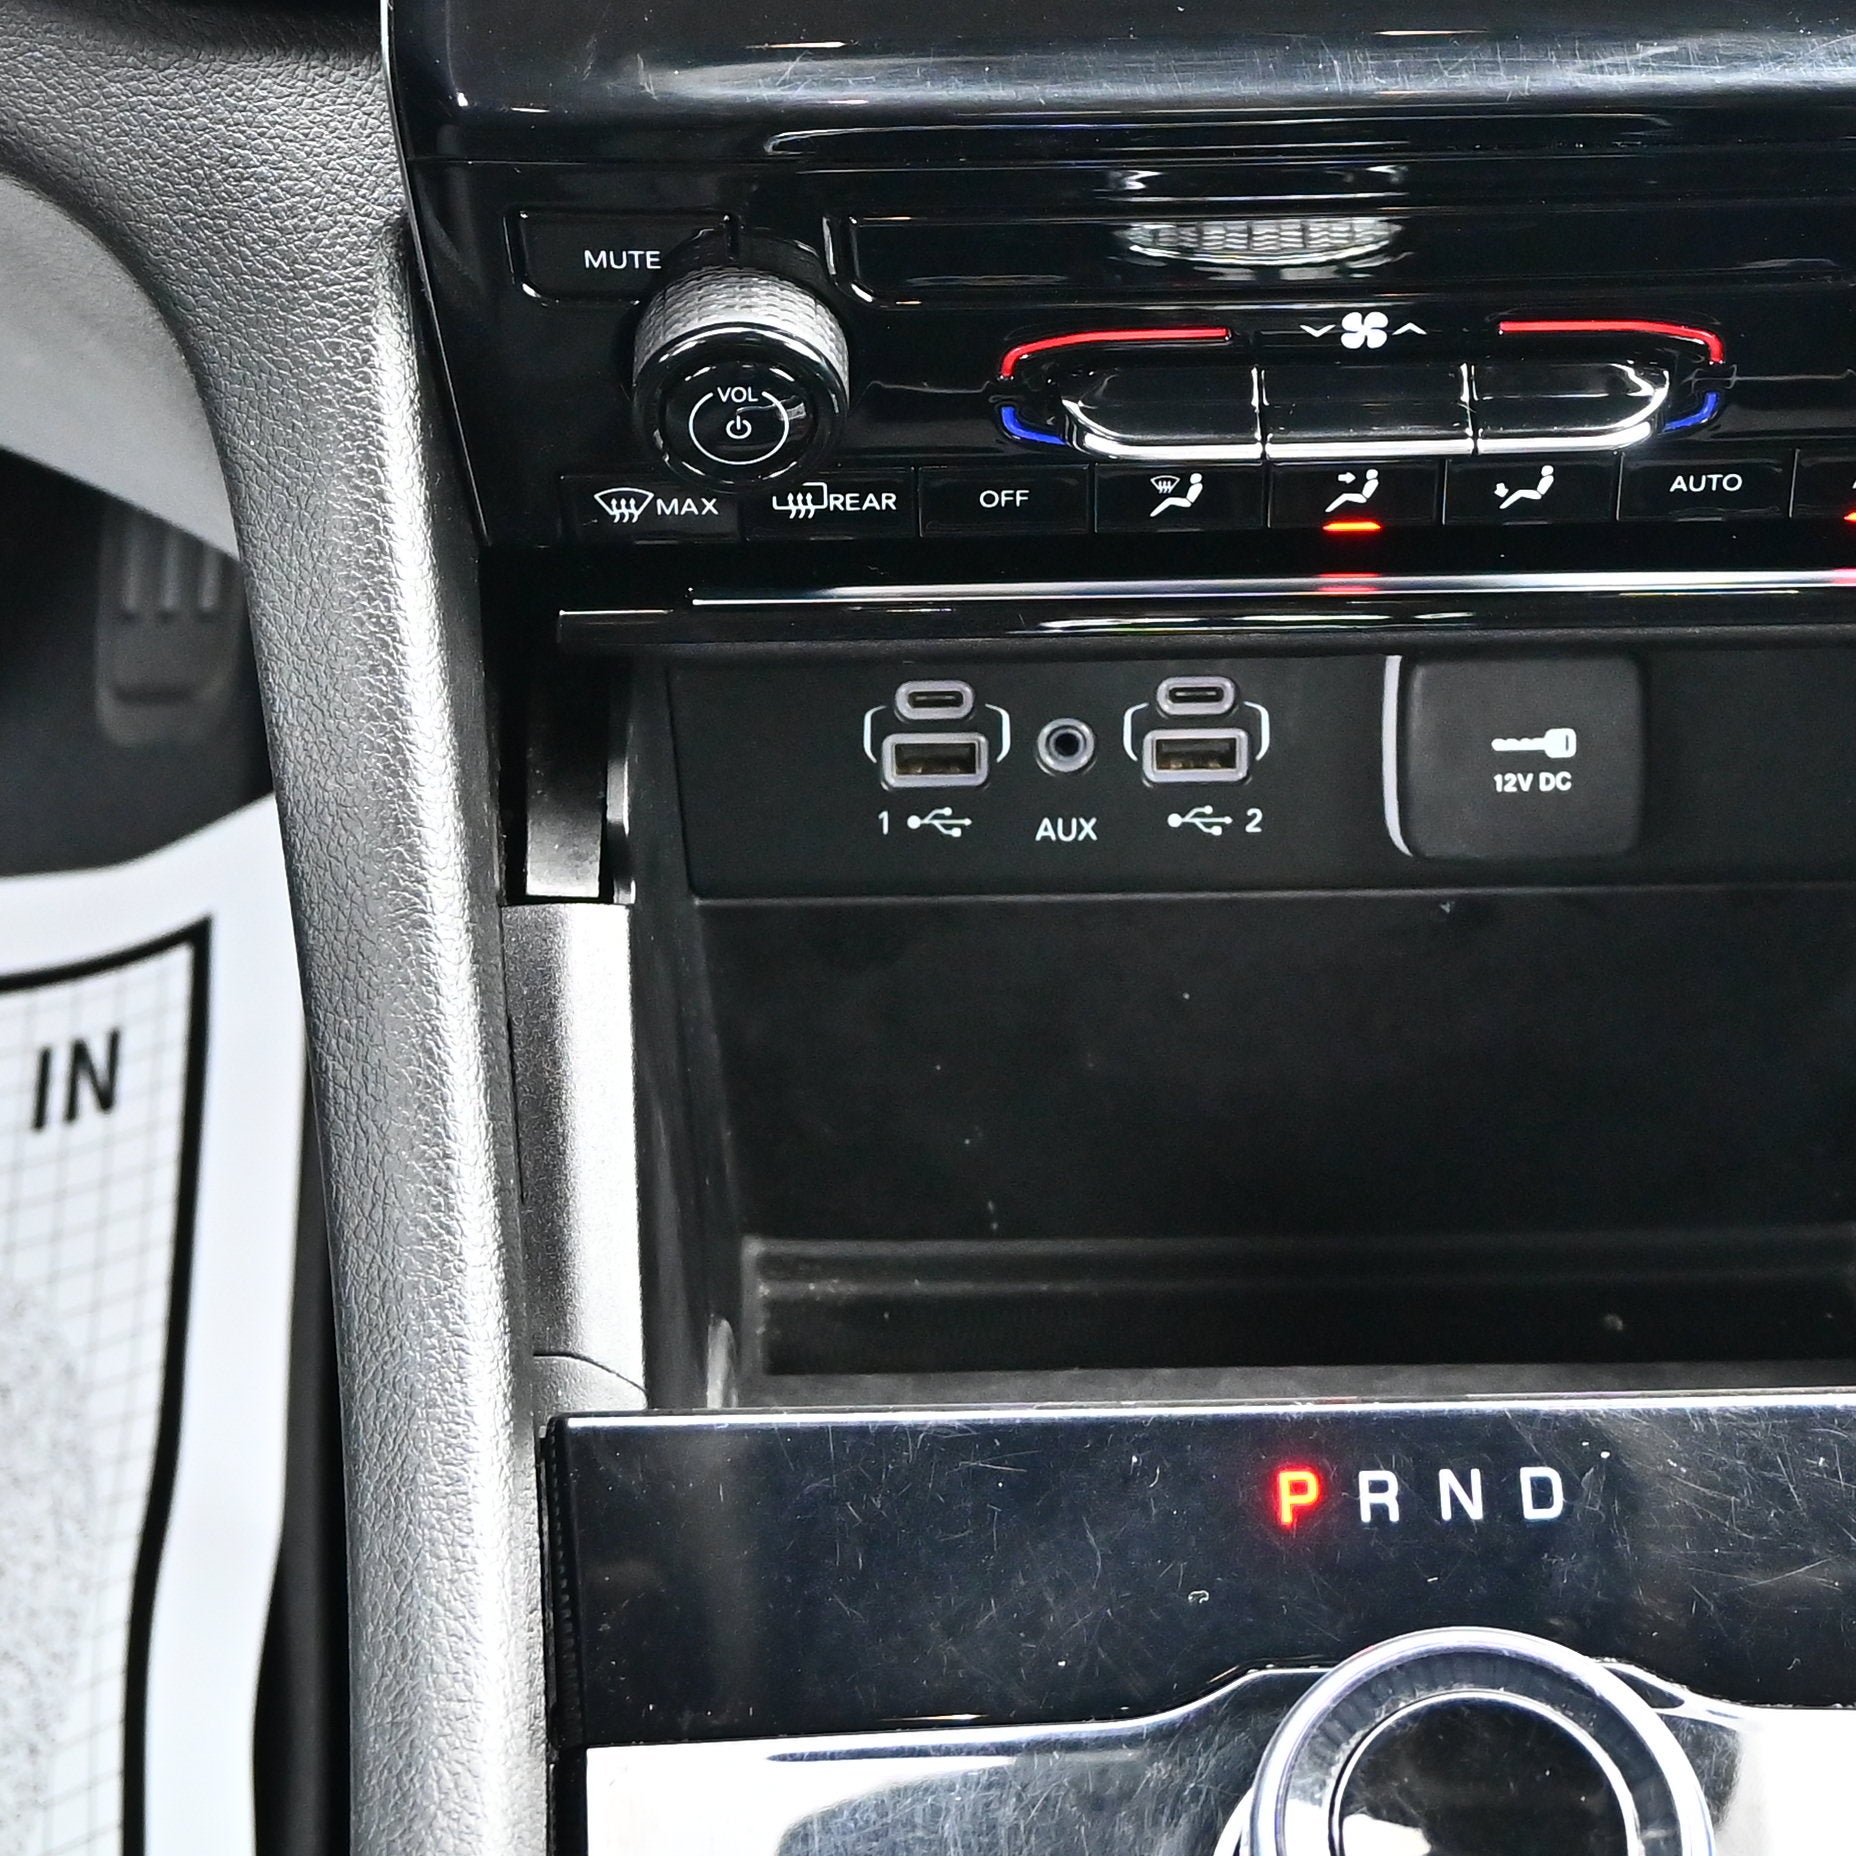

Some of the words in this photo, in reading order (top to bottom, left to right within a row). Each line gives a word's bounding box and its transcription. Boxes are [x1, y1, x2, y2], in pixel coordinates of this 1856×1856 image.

[584, 250, 662, 272] MUTE
[716, 386, 759, 404] VOL
[1670, 472, 1743, 493] AUTO
[656, 497, 719, 517] MAX
[828, 492, 897, 513] REAR
[979, 489, 1029, 509] OFF
[1493, 773, 1531, 793] 12V
[1538, 772, 1572, 791] DC
[878, 811, 890, 834] 1
[1036, 817, 1098, 842] AUX
[1245, 808, 1262, 834] 2
[31, 1030, 122, 1131] IN
[1278, 1470, 1319, 1526] P
[1358, 1470, 1399, 1523] R
[1439, 1468, 1484, 1521] N
[1519, 1466, 1564, 1520] D
